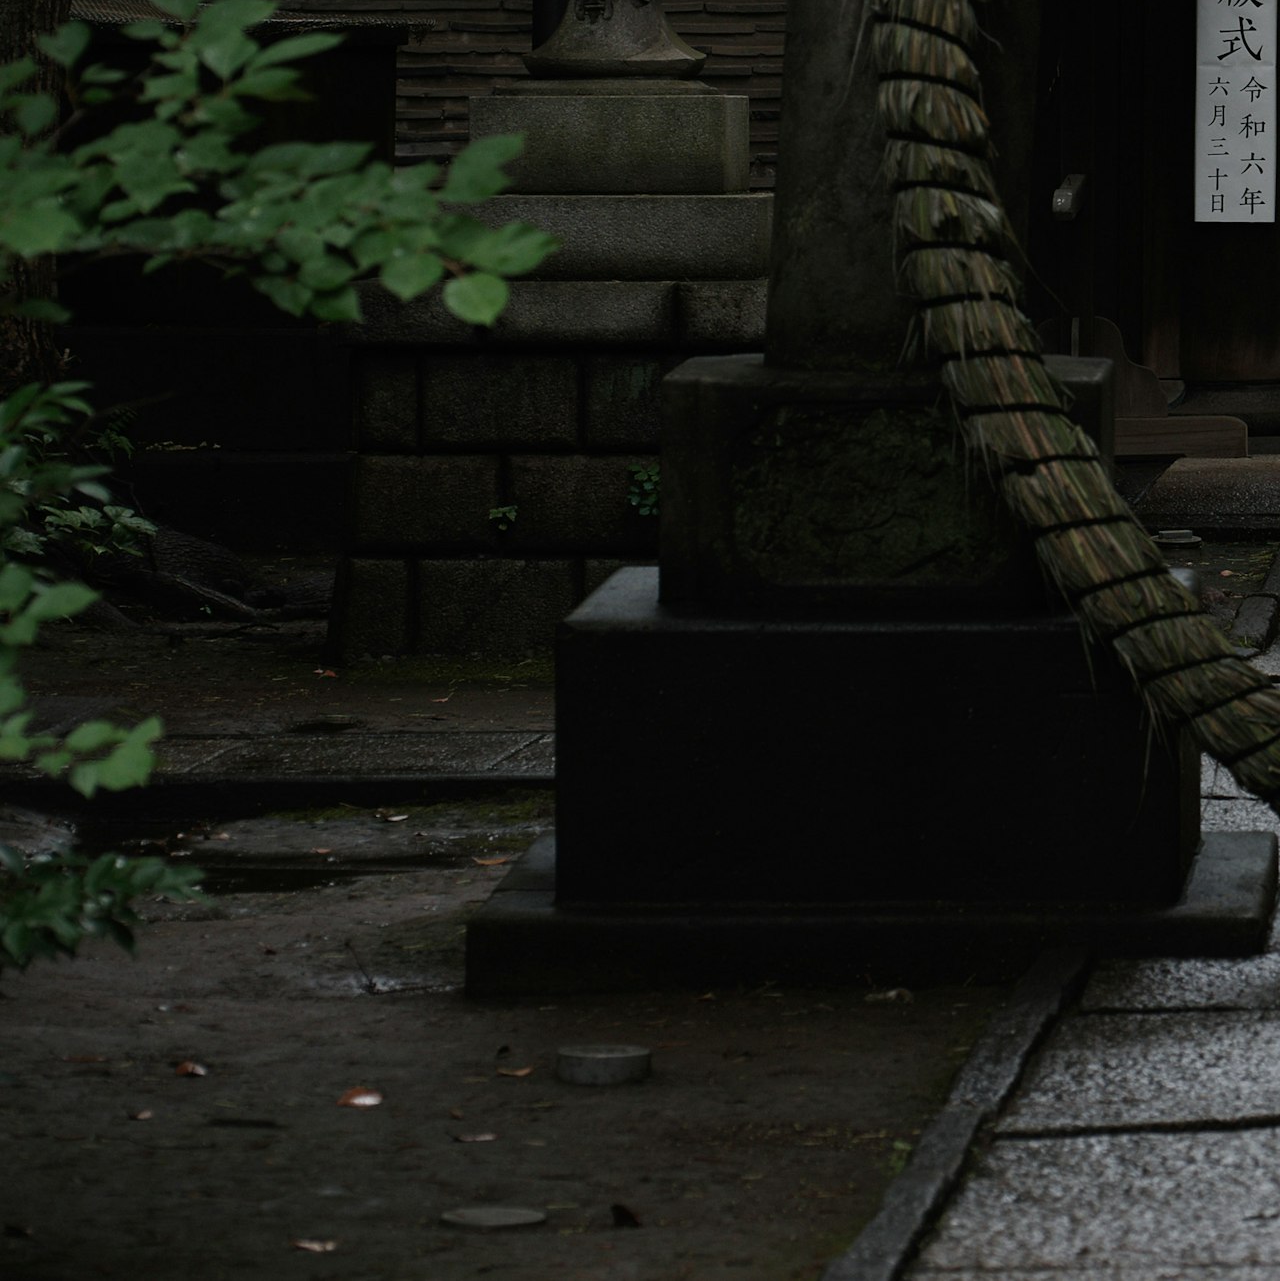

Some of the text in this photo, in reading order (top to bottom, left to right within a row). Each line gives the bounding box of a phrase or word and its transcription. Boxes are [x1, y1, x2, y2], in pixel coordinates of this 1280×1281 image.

[1207, 77, 1230, 213] 六月三十日
[1238, 76, 1268, 215] 令和六年
